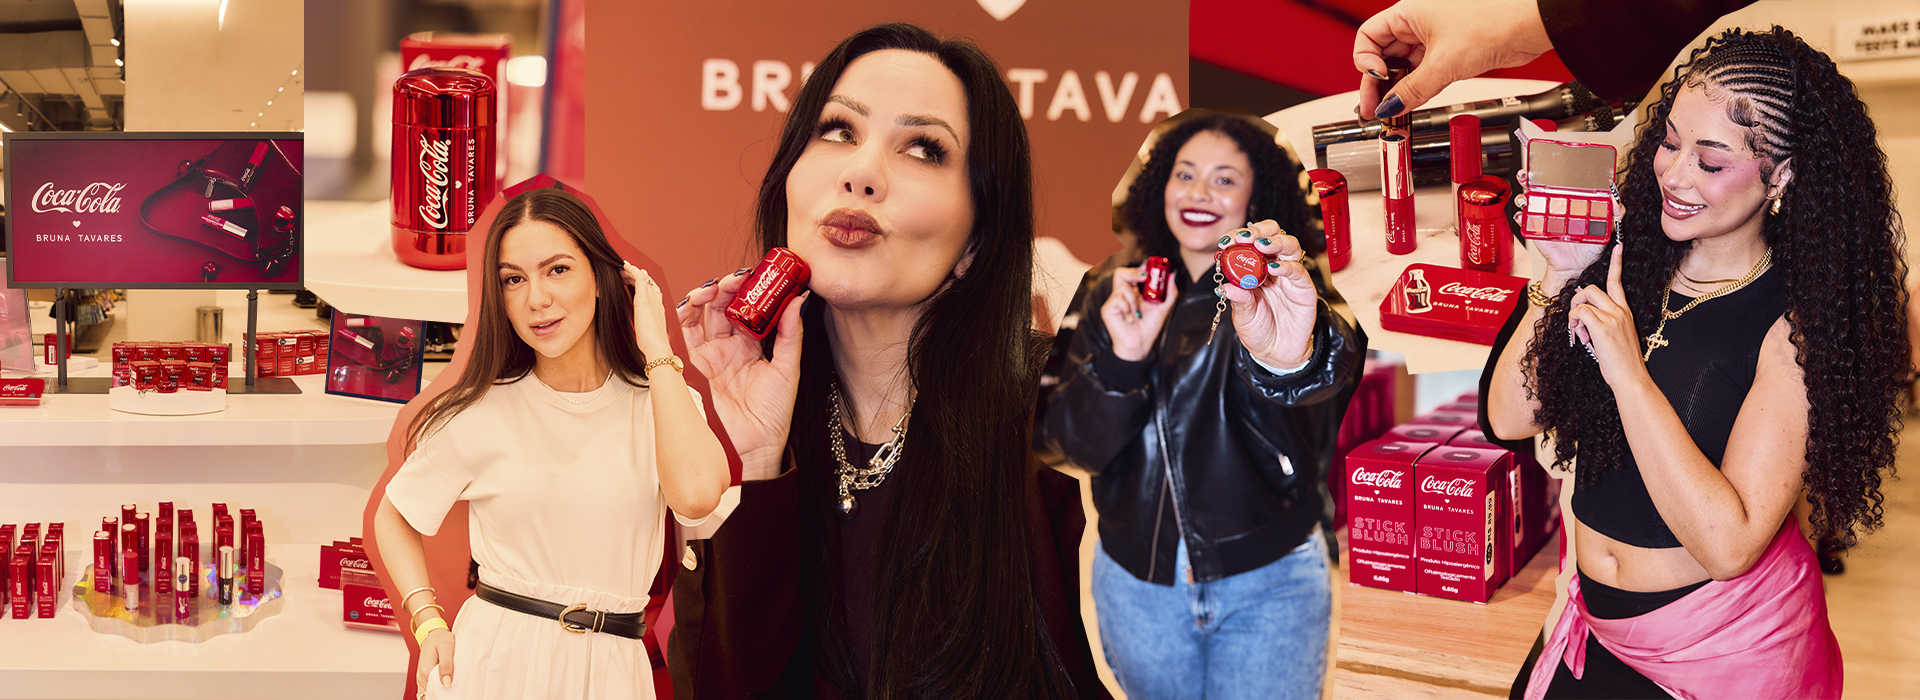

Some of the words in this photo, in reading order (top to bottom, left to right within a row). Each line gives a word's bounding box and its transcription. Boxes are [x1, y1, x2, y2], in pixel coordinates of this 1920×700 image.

[419, 134, 449, 229] Coca-Cola
[31, 181, 127, 214] Coca-Cola
[36, 234, 70, 242] BRUNA
[78, 234, 123, 242] TAVARES
[1438, 282, 1515, 302] Coca-Cola
[1433, 301, 1459, 309] BRUNA
[1465, 305, 1499, 315] TAVARES
[1351, 467, 1404, 489] Coca-Cola
[1421, 475, 1476, 498] Coca-Cola
[1377, 497, 1403, 505] TAVARES
[1447, 506, 1474, 514] TAVARES
[1354, 517, 1406, 533] STICK
[1352, 528, 1408, 545] BLUSH
[1423, 526, 1476, 543] STICK
[1421, 537, 1478, 555] BLUSH
[1420, 556, 1440, 564] Produto
